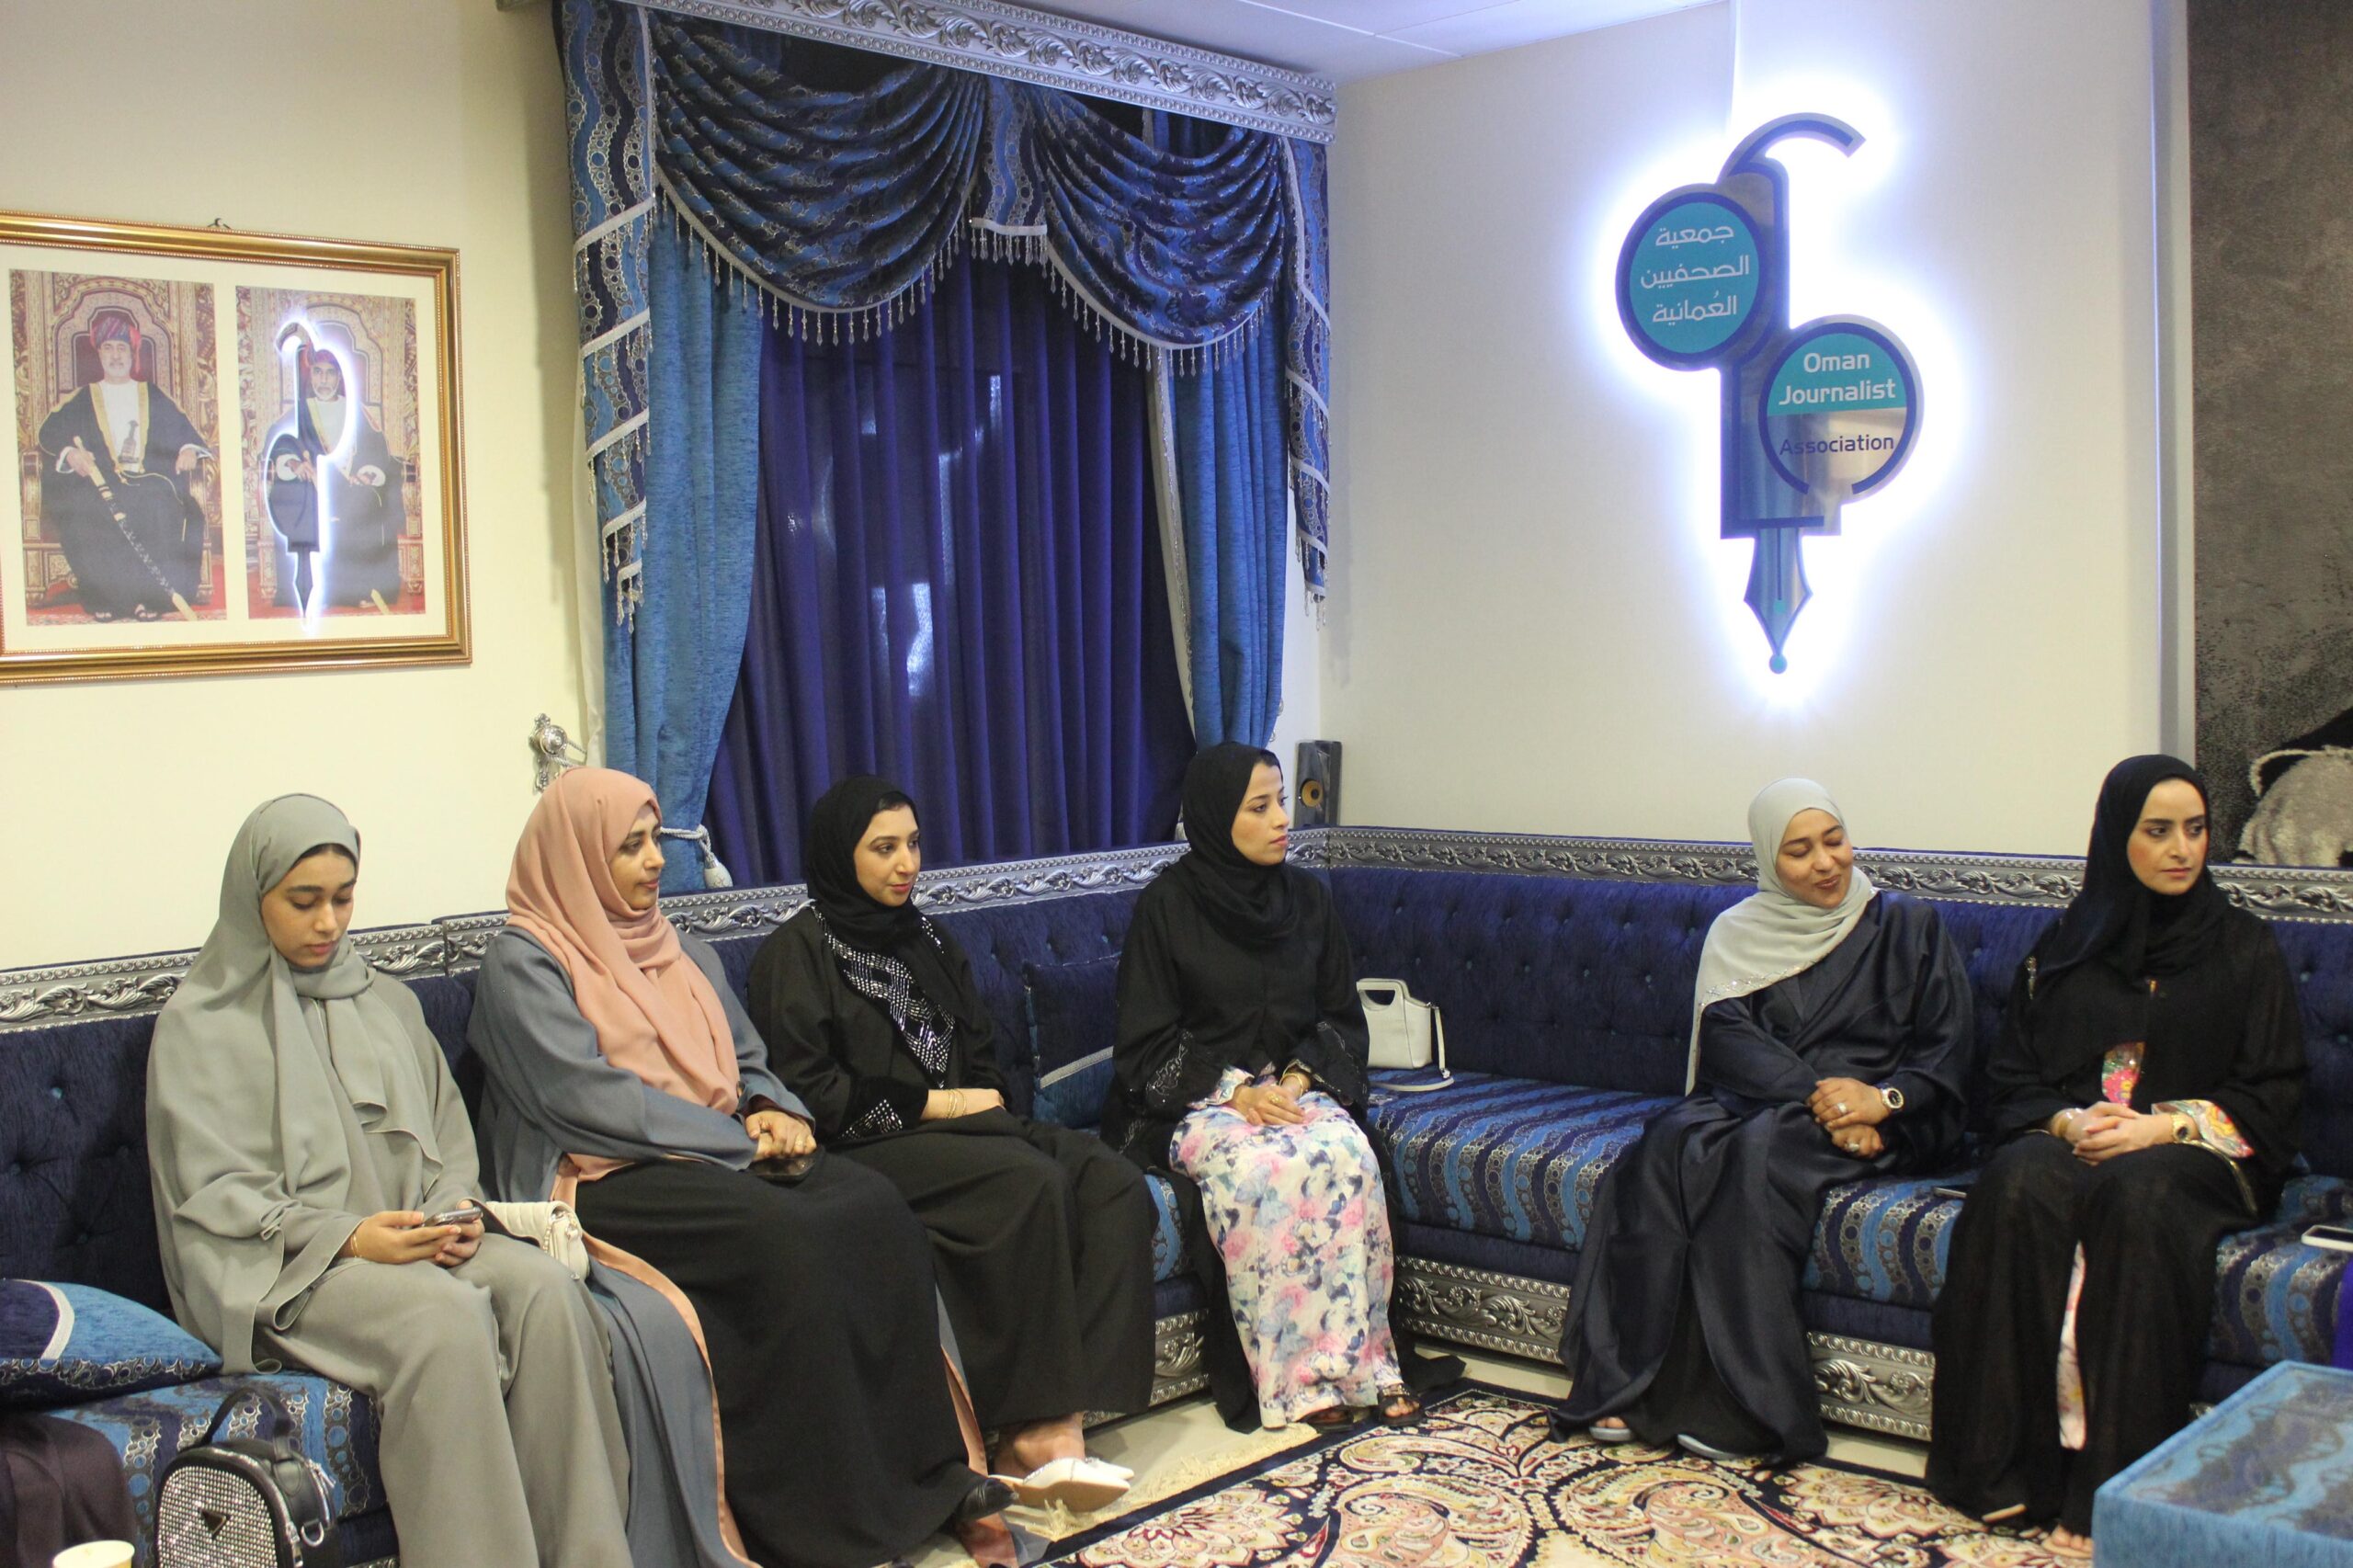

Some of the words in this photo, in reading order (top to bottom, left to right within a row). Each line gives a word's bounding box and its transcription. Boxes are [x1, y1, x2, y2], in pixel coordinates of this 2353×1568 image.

[1655, 225, 1734, 249] جمعية
[1641, 255, 1750, 290] الصحفيين
[1803, 352, 1870, 373] Oman
[1779, 378, 1896, 406] Journalist
[1779, 434, 1894, 456] Association
